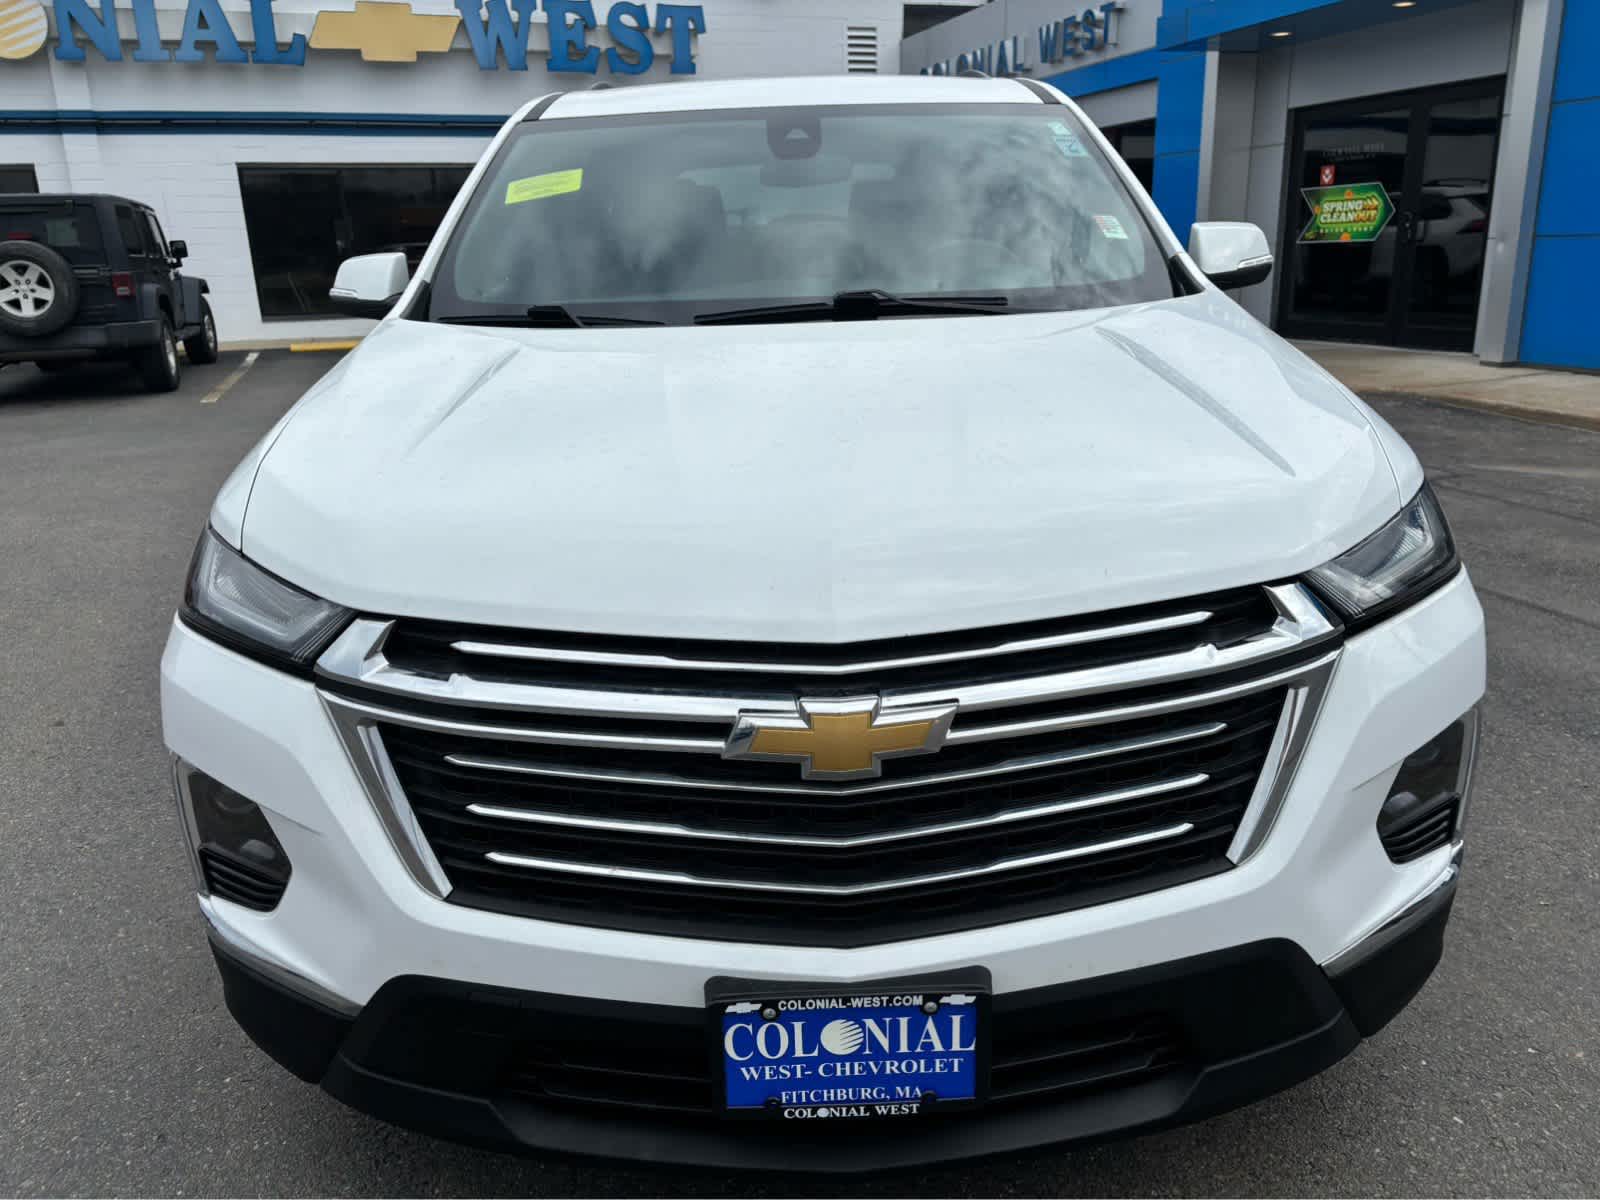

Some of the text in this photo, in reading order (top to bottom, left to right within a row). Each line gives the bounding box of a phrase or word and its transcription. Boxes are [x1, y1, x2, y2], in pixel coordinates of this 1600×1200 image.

[455, 0, 705, 74] WEST
[1039, 2, 1117, 64] WEST
[1323, 200, 1363, 212] SPRING
[778, 996, 923, 1011] COLONIAL-WEST.COM
[724, 1015, 976, 1061] COLONIAL
[740, 1058, 964, 1081] WEST- CHEVROLET
[781, 1086, 922, 1104] FITCHBURG, MA
[784, 1103, 920, 1119] COLONIAL WEST
